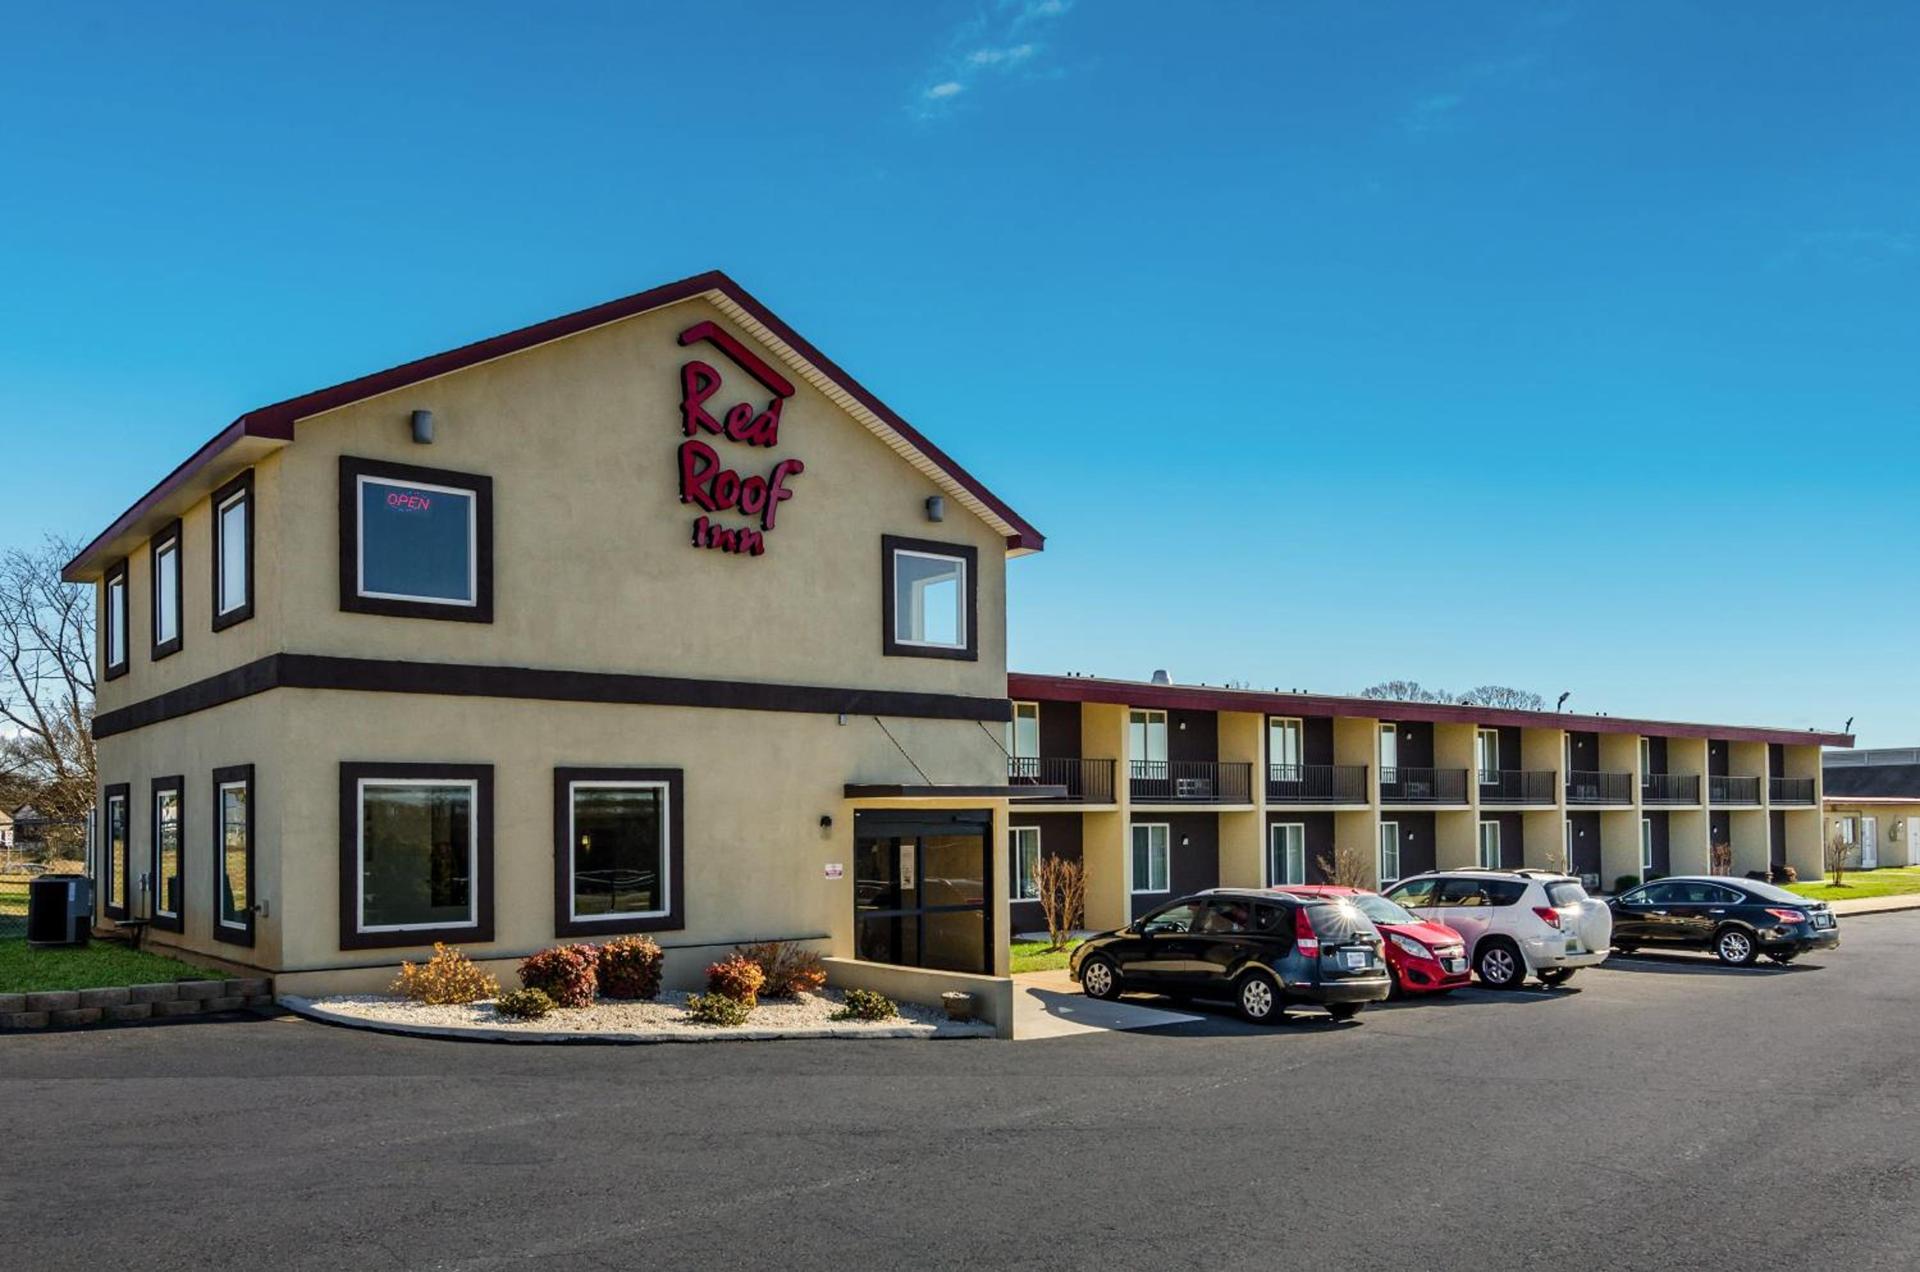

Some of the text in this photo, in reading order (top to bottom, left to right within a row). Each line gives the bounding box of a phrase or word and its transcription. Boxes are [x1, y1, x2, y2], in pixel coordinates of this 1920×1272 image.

[680, 360, 784, 447] Red
[387, 493, 431, 511] OPEN
[678, 439, 805, 531] Roof
[692, 515, 765, 556] Inn
